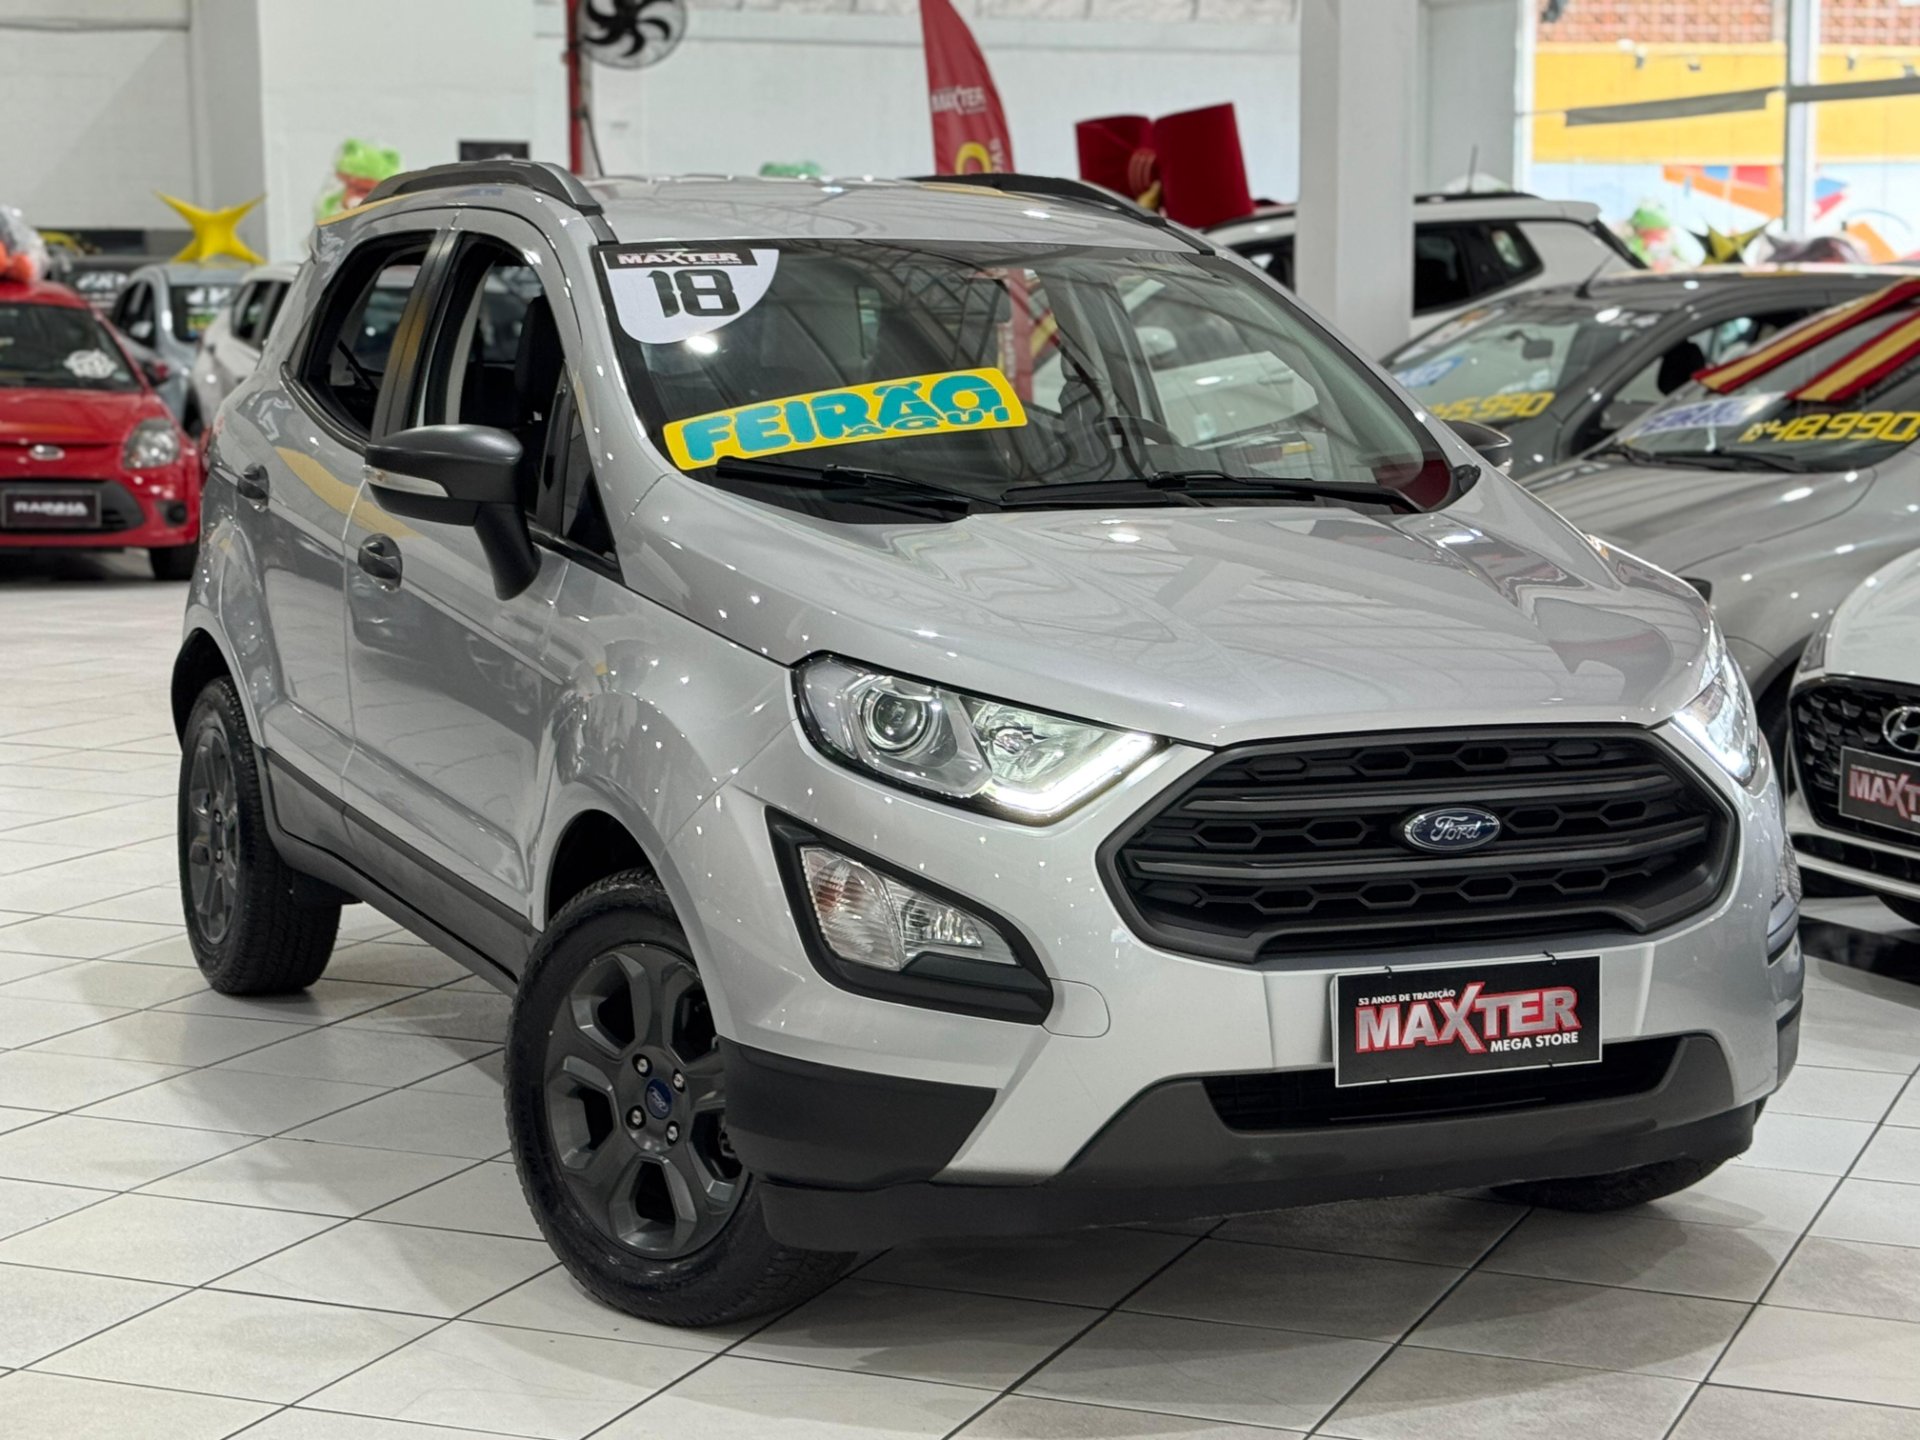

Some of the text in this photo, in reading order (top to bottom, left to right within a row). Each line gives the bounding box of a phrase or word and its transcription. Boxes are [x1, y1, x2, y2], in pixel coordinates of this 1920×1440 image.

[617, 251, 741, 265] MAXTER
[647, 269, 740, 318] 18
[682, 374, 1004, 461] FEIRÃO
[1430, 815, 1482, 841] Ford
[1371, 994, 1397, 1005] ANOS
[1398, 993, 1410, 1002] DE
[1412, 988, 1456, 1001] TRADIÇÃO
[1356, 981, 1582, 1054] MAXTER
[1490, 1031, 1579, 1053] MEGA STORE
